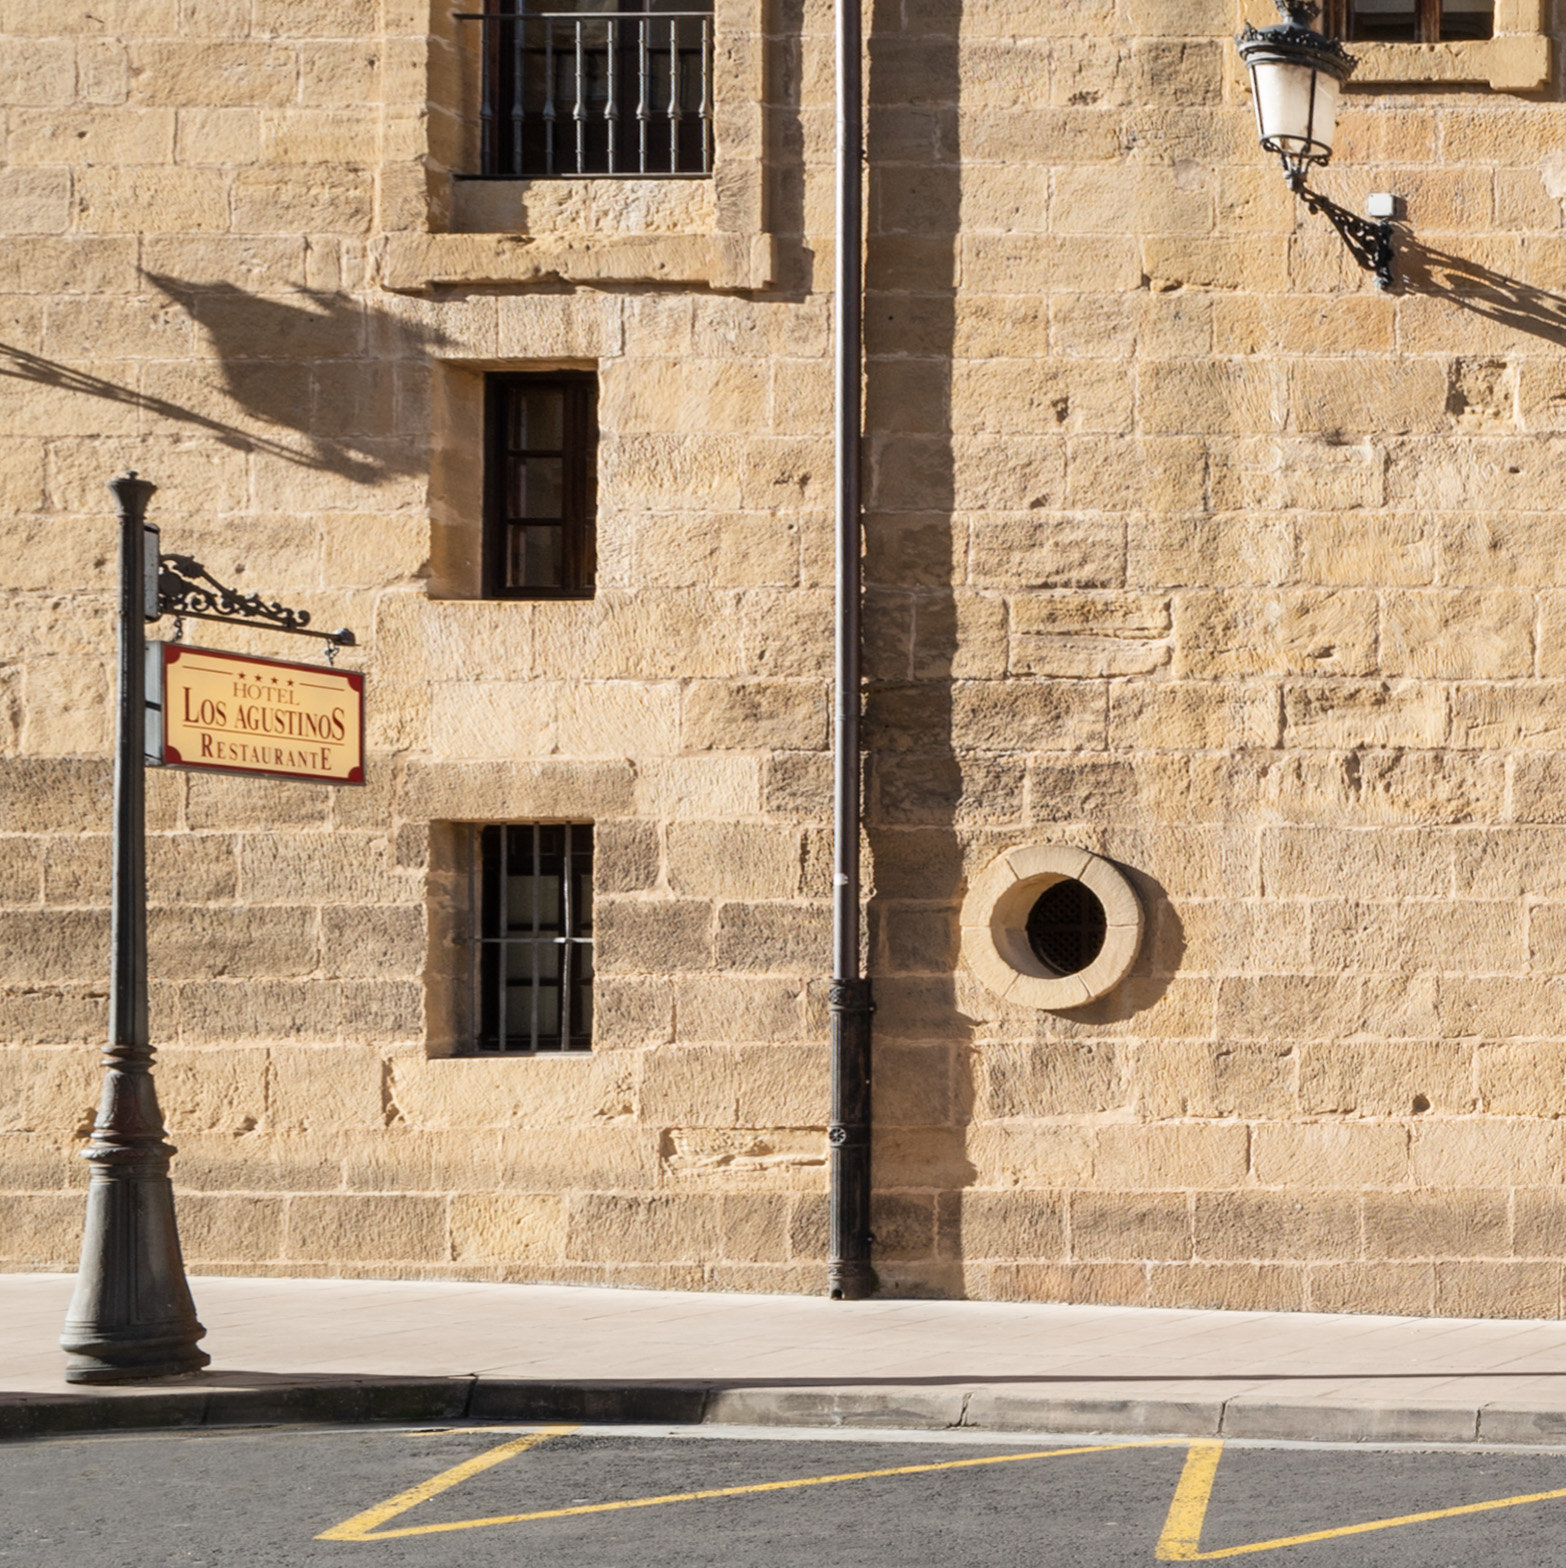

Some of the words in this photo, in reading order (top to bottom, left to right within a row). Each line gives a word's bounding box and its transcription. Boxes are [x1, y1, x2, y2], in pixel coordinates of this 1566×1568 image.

[233, 682, 300, 706] HOTEL
[183, 687, 227, 727] LOS
[235, 704, 345, 741] AGUSTINOS
[201, 733, 332, 771] RESTAURANTE
